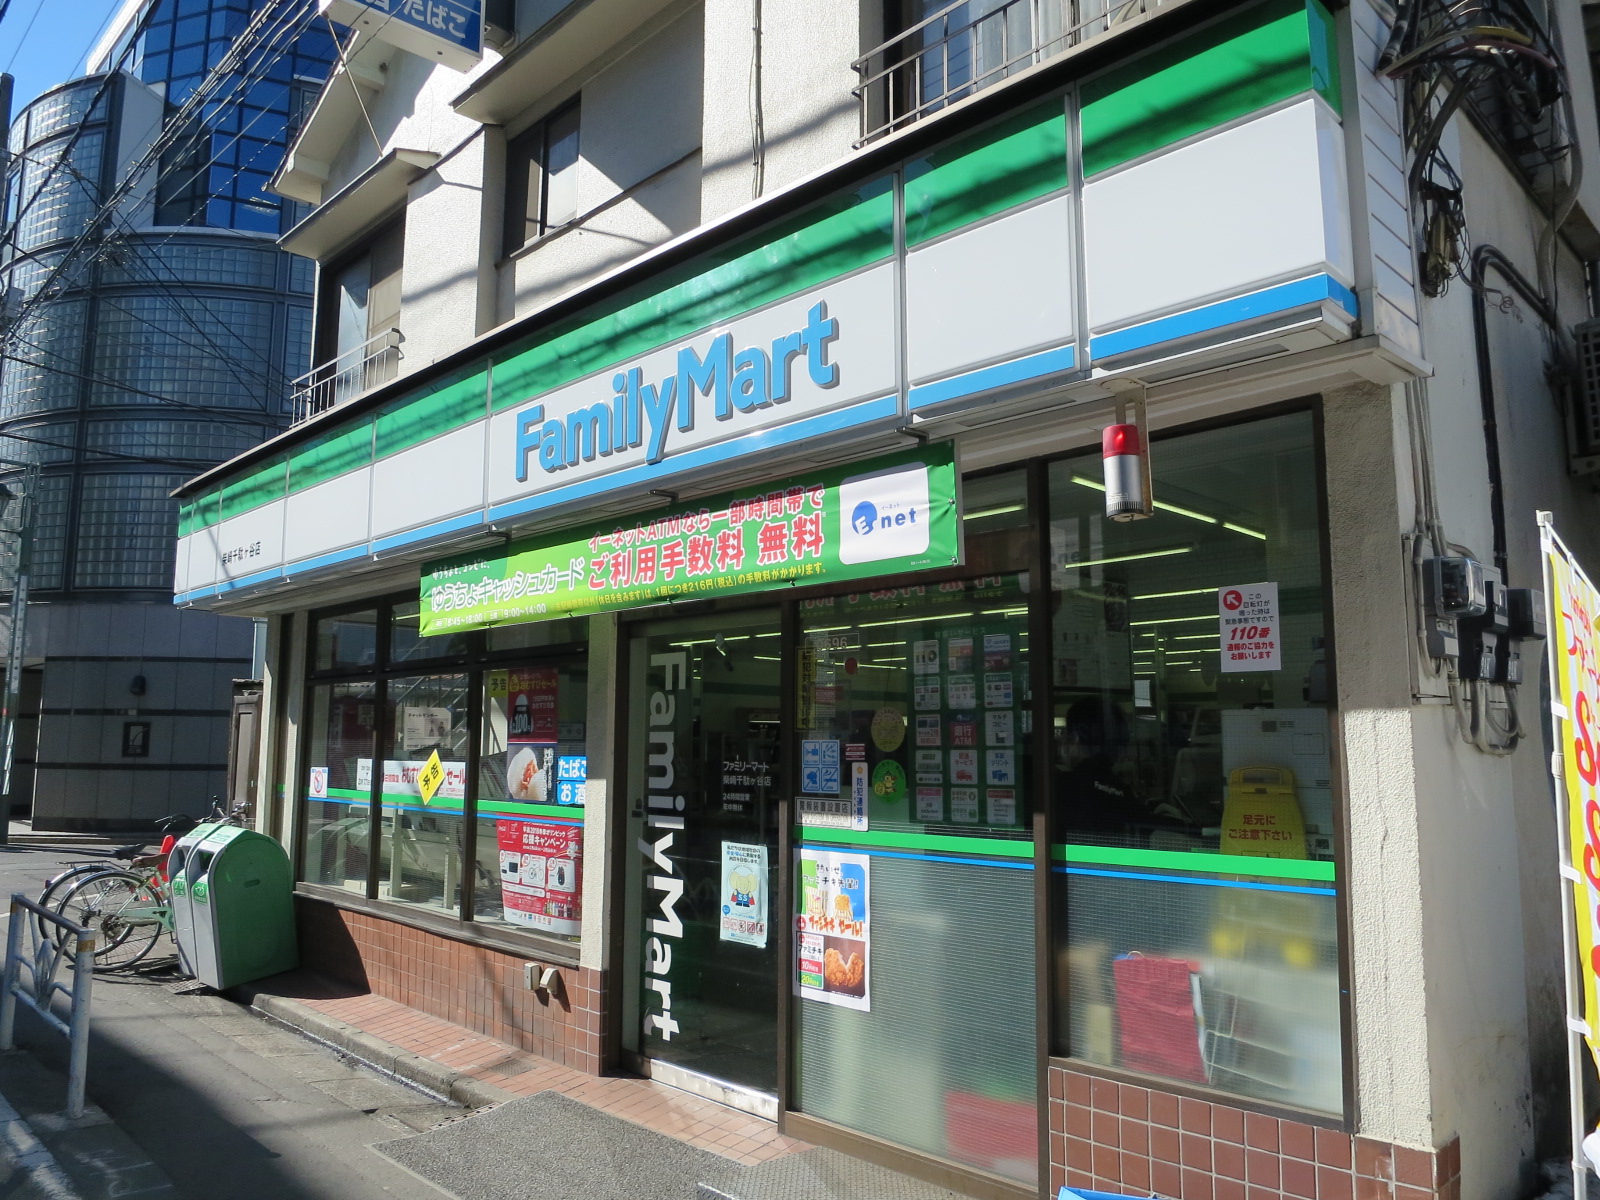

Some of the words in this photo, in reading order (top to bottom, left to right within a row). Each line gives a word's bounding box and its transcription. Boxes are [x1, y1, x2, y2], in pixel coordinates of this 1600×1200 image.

[404, 0, 466, 39] たばこ
[515, 298, 840, 482] FamilyMart
[588, 483, 826, 553] イーネットATMなら一部時間帯で
[588, 528, 745, 590] ご利用手数料
[757, 511, 826, 566] 無料
[431, 555, 586, 614] ゆうちょキャッシュカード
[1243, 600, 1270, 609] 回転灯が
[1225, 616, 1274, 625] 緊急事態ですので
[1231, 625, 1271, 640] 110番
[1227, 641, 1275, 651] 通報のご協力を
[1231, 651, 1272, 660] お願いします
[491, 677, 507, 691] 予告
[954, 725, 972, 737] 銀行
[954, 737, 972, 745] ATM
[723, 761, 770, 773] ファミリーマート
[423, 763, 440, 791] 予告
[723, 793, 750, 801] 24時間営業
[856, 777, 864, 825] 防犯連絡所
[1242, 814, 1276, 826] 足元に
[1228, 828, 1293, 841] ご注意下さい
[522, 835, 566, 848] 応援キャンペーン
[638, 651, 687, 1042] FamilyMart
[808, 915, 835, 933] ファミチキ
[798, 944, 822, 956] ファミチキ
